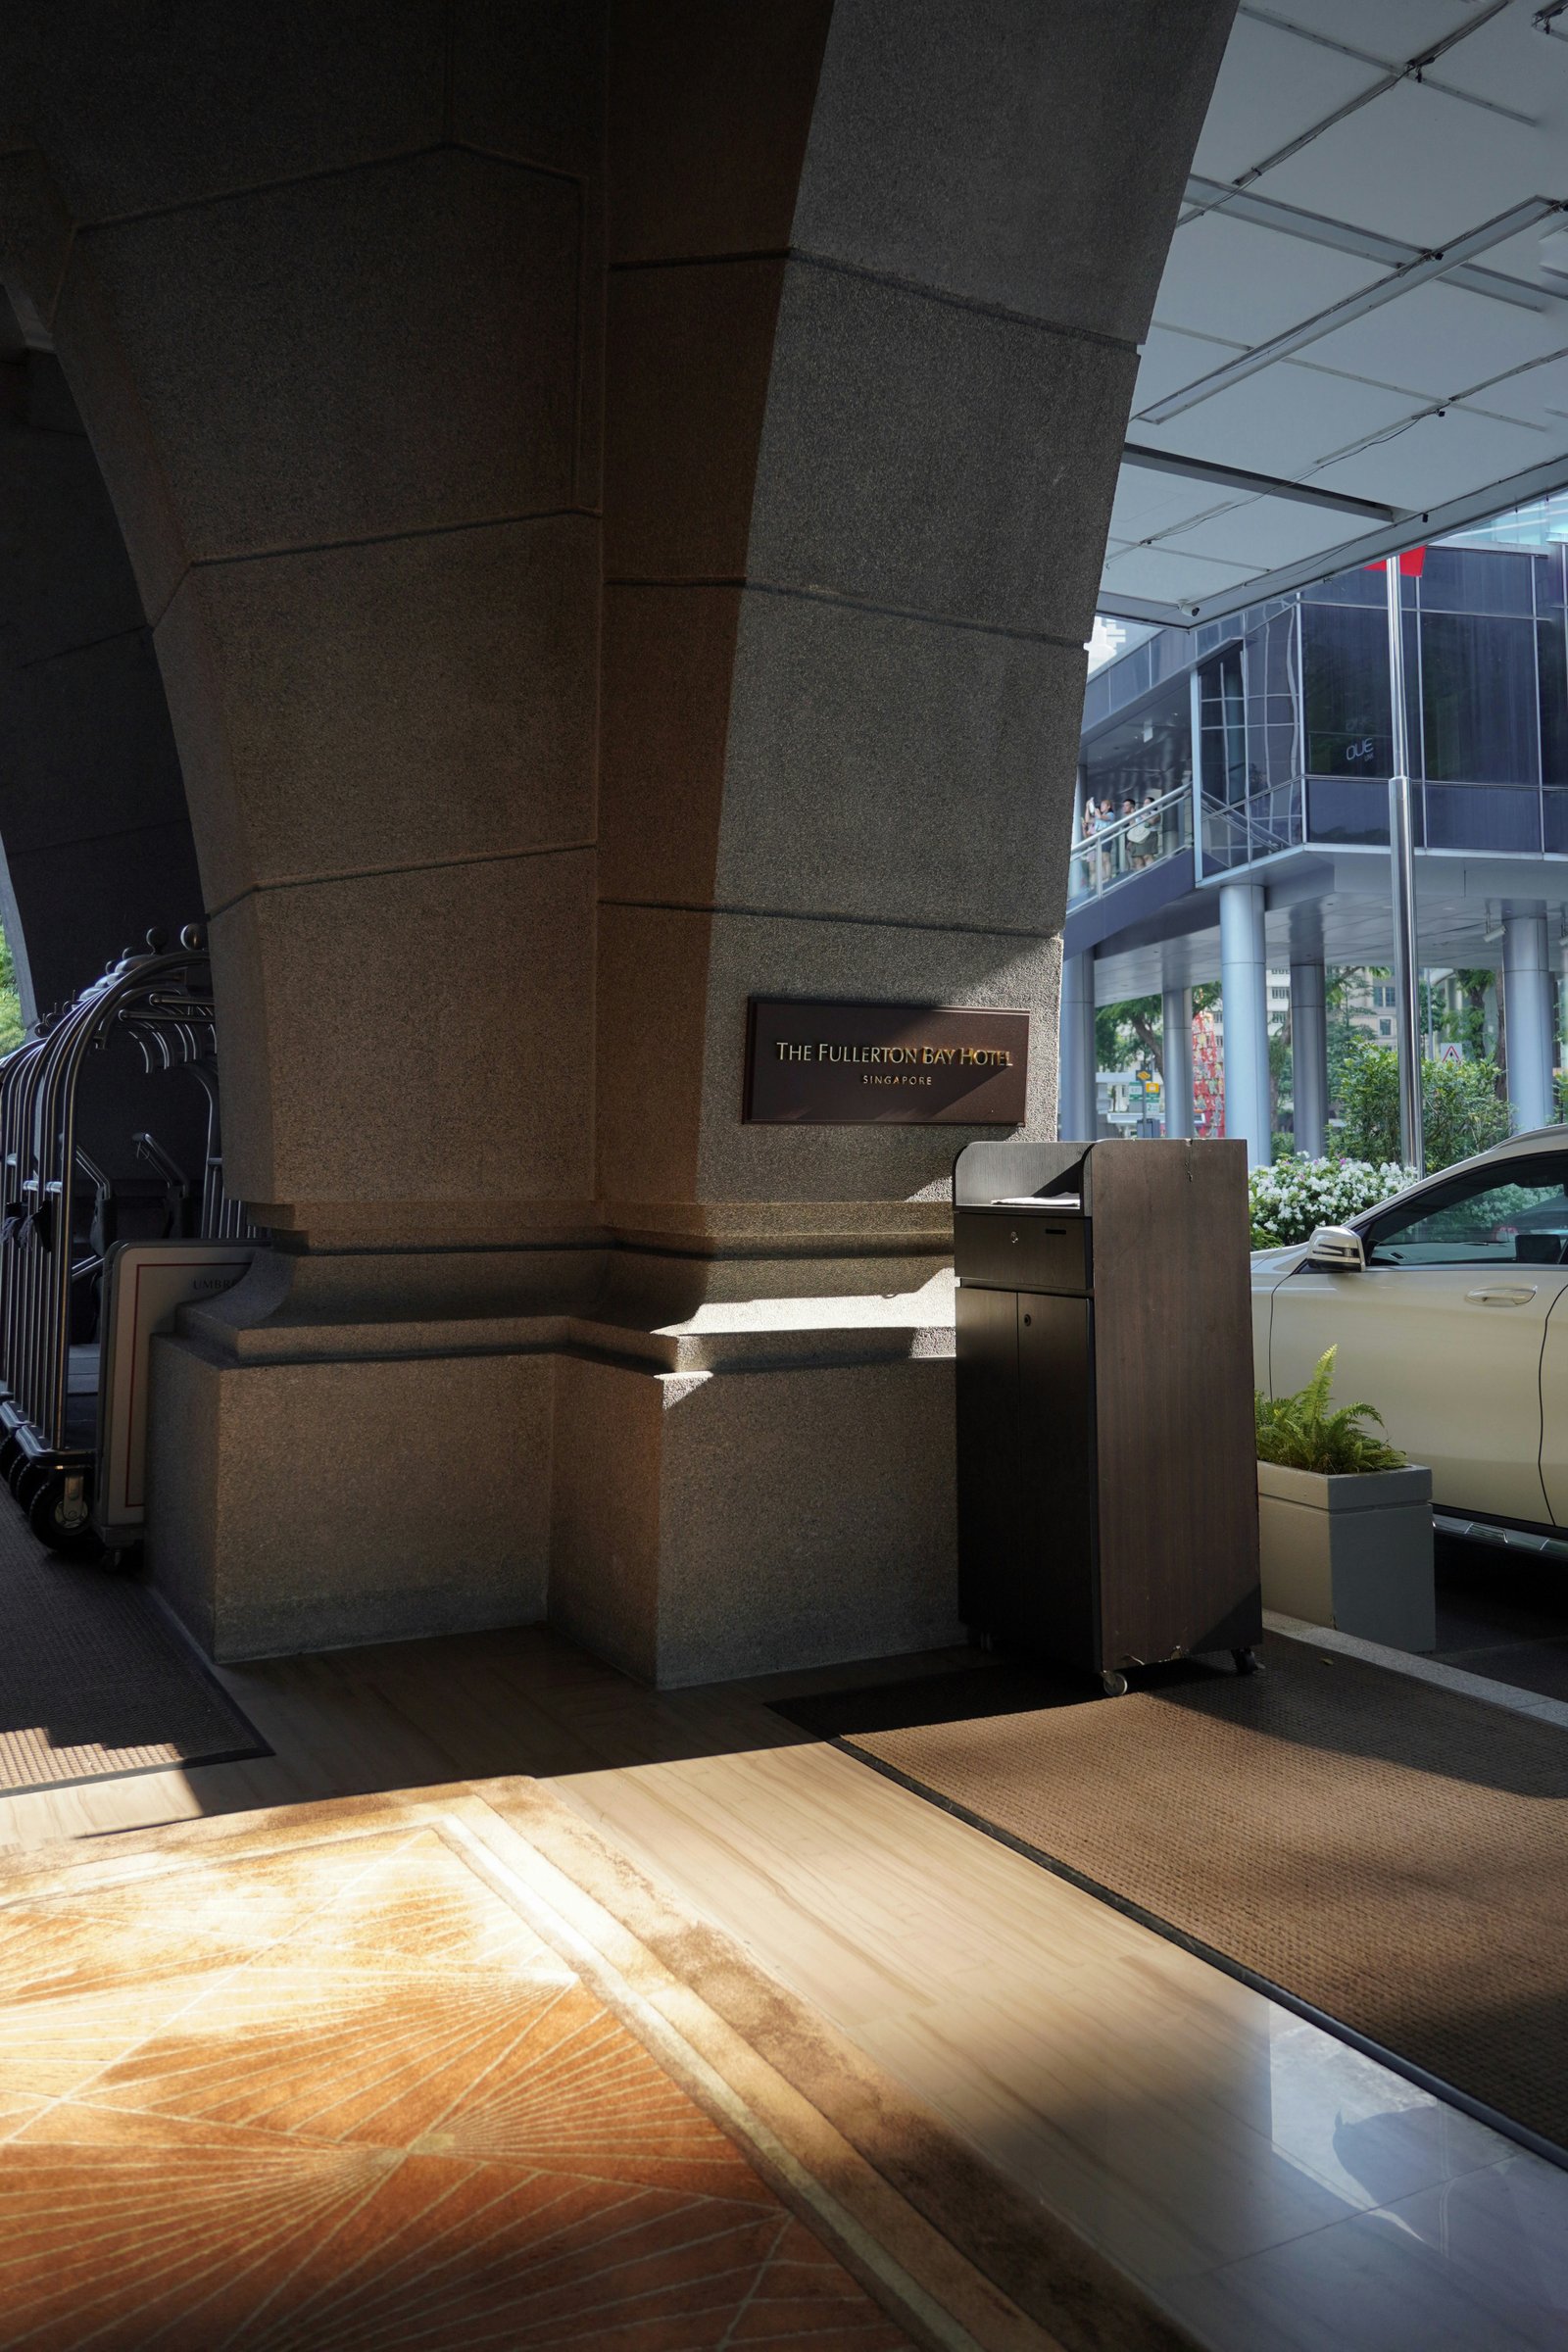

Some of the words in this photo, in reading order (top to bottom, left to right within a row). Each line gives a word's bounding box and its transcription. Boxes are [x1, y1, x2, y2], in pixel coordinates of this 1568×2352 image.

[1347, 738, 1374, 760] OUE
[776, 1042, 812, 1061] THE
[818, 1044, 917, 1064] FULLERTON
[922, 1047, 956, 1065] BAY
[959, 1048, 1013, 1066] HOTEL
[862, 1075, 932, 1086] SINGAPORE
